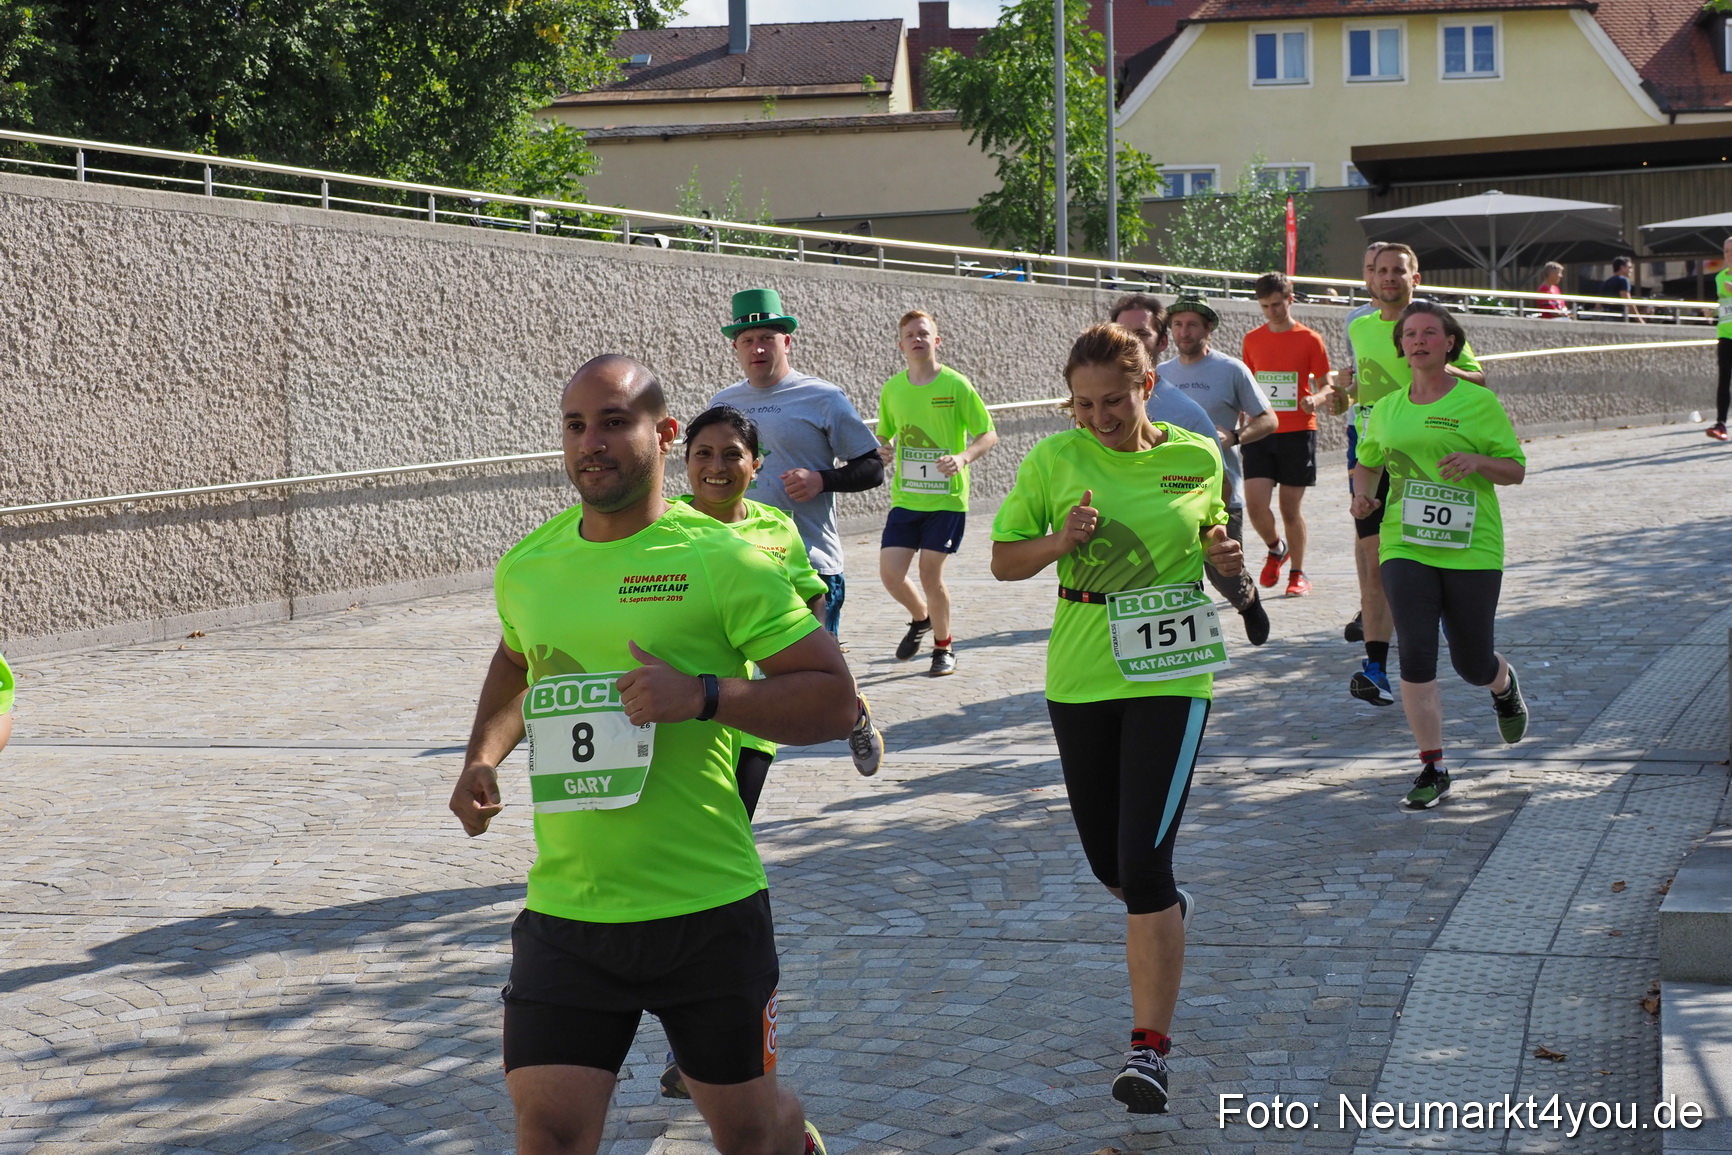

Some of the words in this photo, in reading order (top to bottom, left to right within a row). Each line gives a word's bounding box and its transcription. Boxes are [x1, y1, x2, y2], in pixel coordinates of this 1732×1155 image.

[1257, 373, 1294, 383] BOCK
[1270, 385, 1278, 397] 2
[920, 465, 927, 478] 1
[905, 479, 945, 489] JONATHAN
[1409, 483, 1470, 505] BOCK
[1422, 505, 1452, 526] 50
[1416, 528, 1452, 541] KATJA
[623, 574, 687, 584] NEUMARKTER
[618, 583, 689, 594] ELEMENTELAUF
[629, 595, 665, 604] September
[1116, 588, 1206, 617] BOCK
[1137, 614, 1197, 650] 151
[1129, 648, 1215, 671] KATARZYNA
[572, 722, 595, 763] 8
[564, 775, 612, 795] GARY
